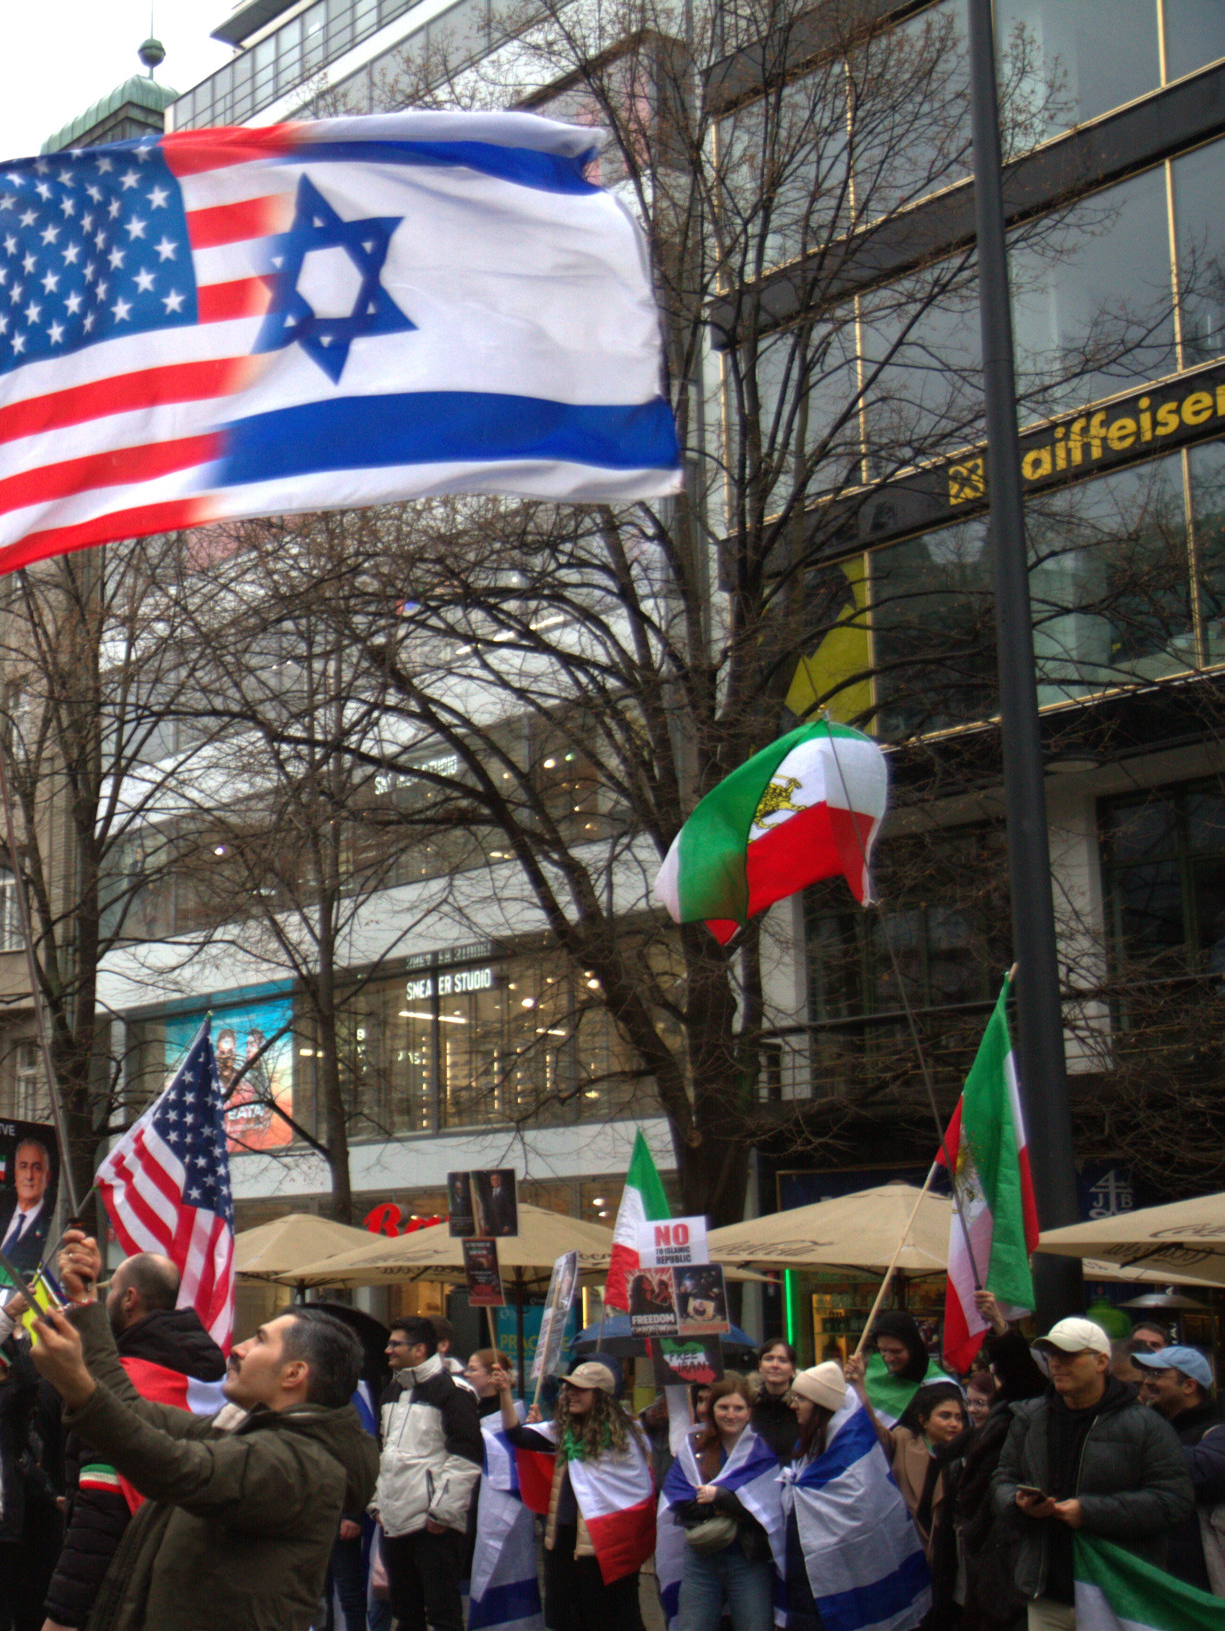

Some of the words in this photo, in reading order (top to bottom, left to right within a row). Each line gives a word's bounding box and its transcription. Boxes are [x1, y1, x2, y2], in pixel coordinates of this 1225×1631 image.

[1021, 384, 1225, 481] aiffeise
[406, 974, 452, 1000] SNEAER
[454, 968, 492, 993] STUDIO
[654, 1223, 690, 1247] NO
[664, 1246, 691, 1255] ISLAMIC
[656, 1254, 692, 1265] REPUBLIC
[631, 1313, 675, 1325] FREEDOM
[669, 1349, 698, 1362] FREE
[678, 1360, 707, 1374] IRAN
